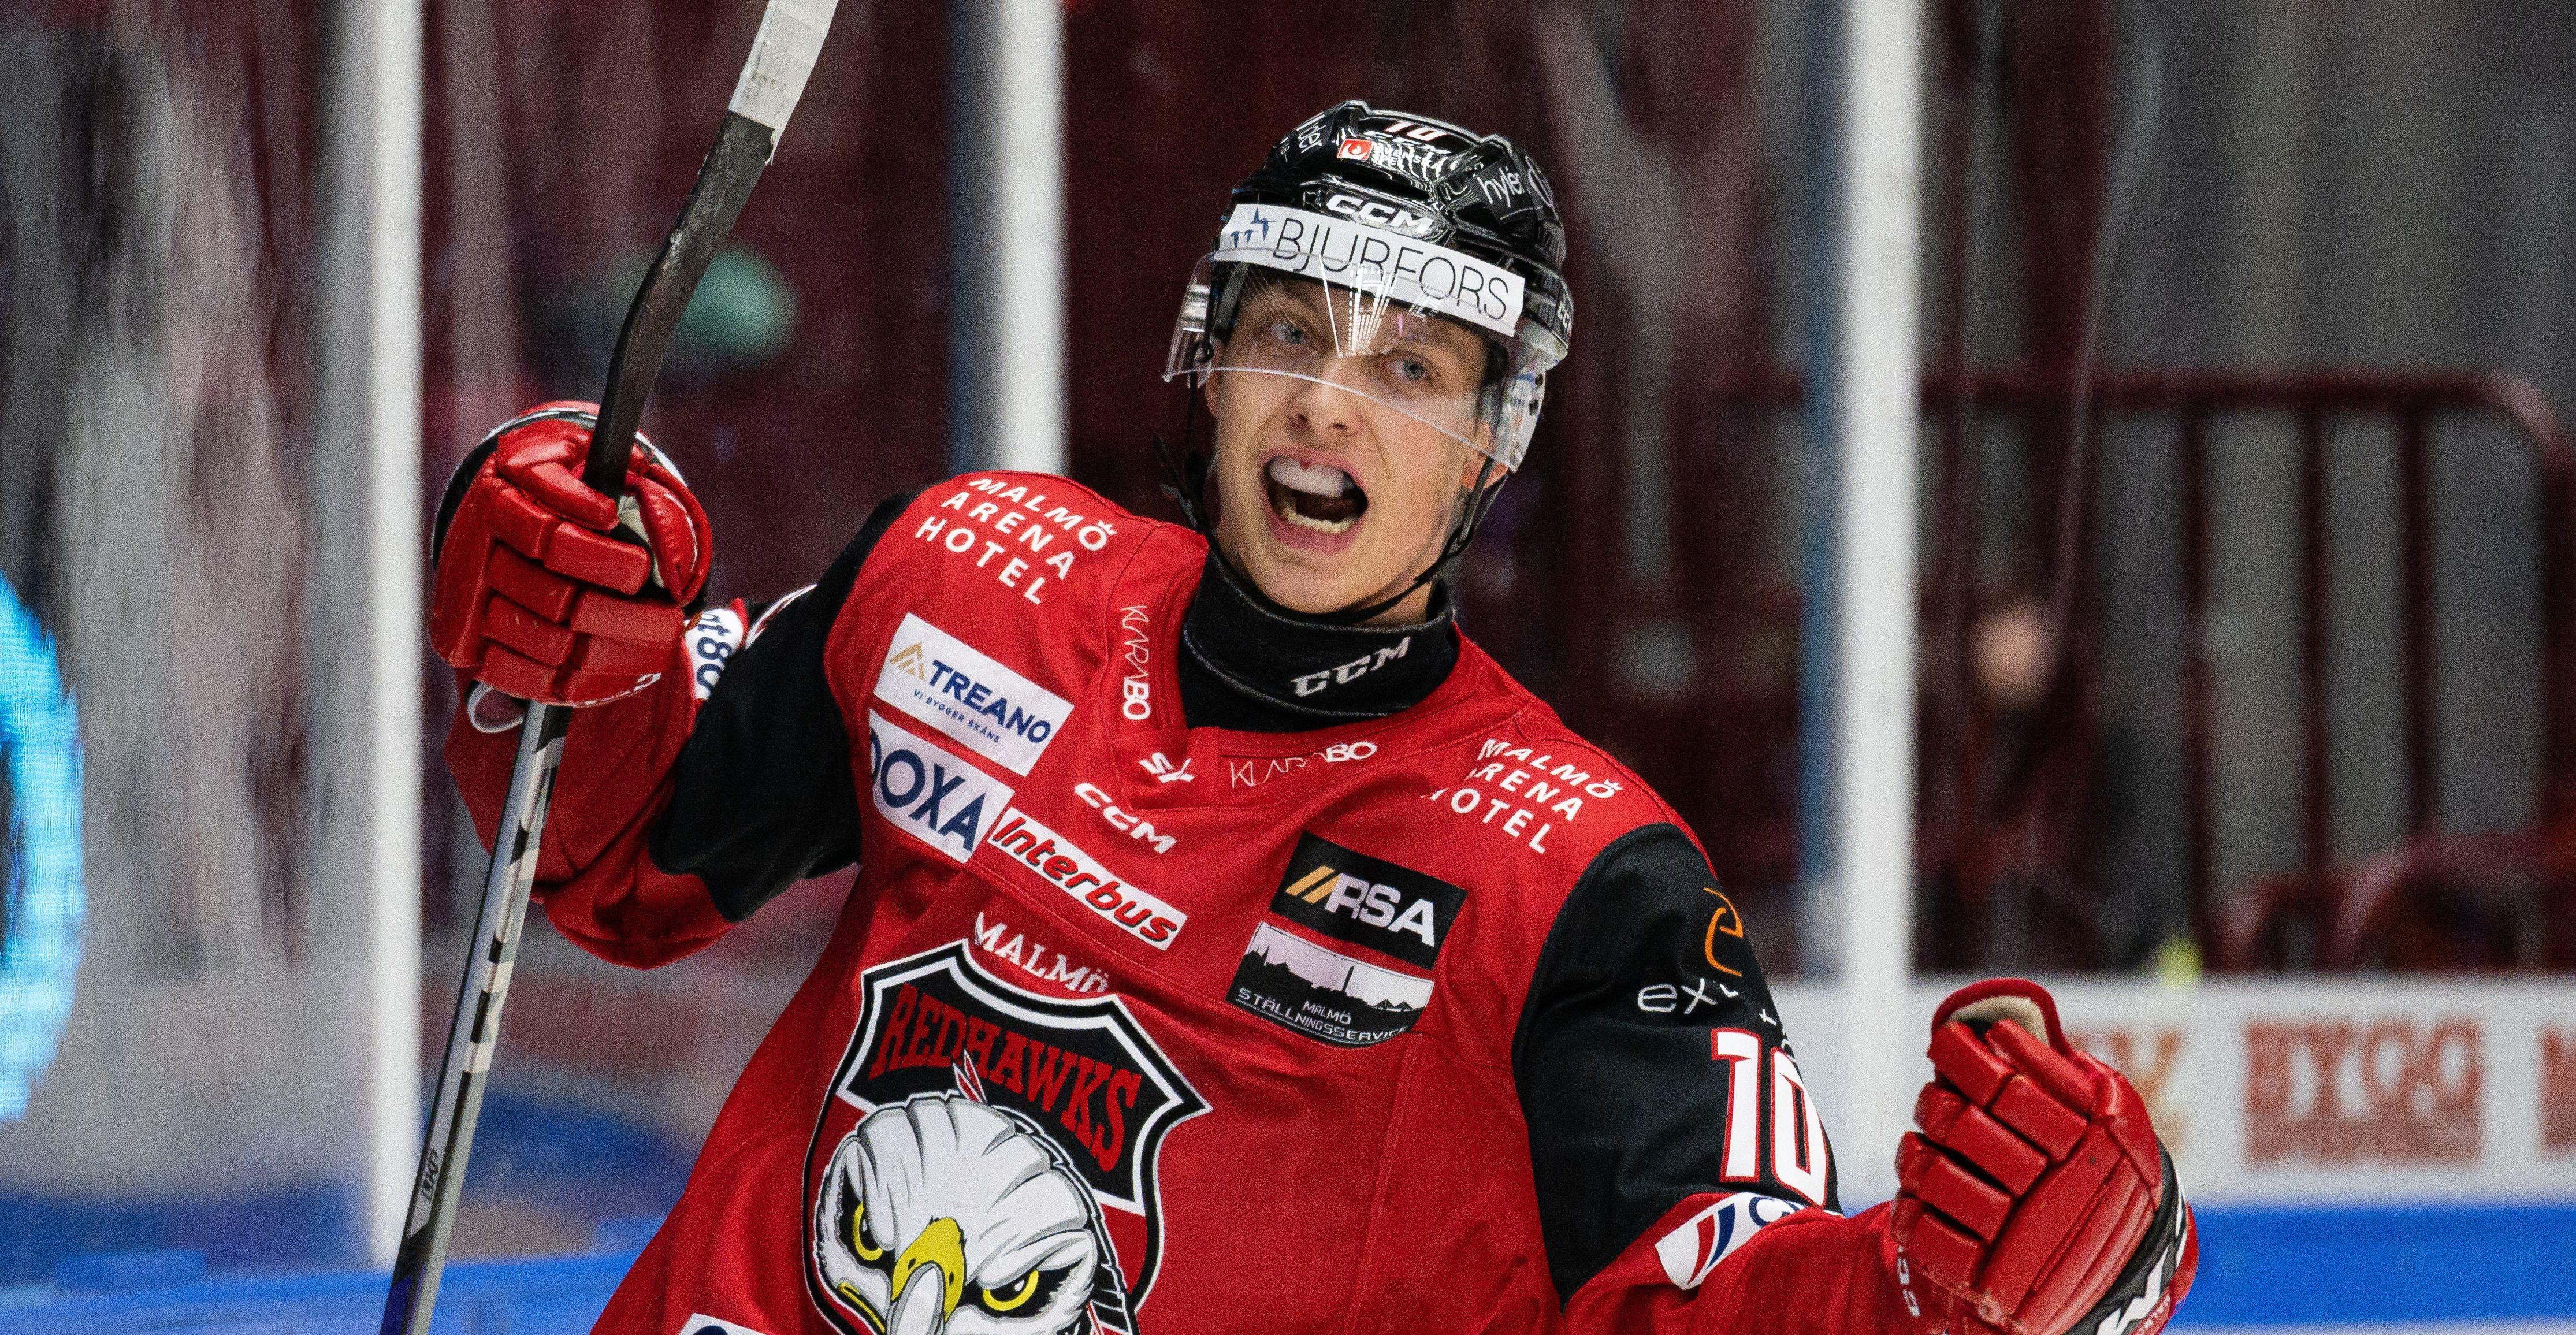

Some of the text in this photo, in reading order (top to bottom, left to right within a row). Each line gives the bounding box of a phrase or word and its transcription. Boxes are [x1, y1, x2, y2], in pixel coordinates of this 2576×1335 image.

[1326, 195, 1435, 233] CCM
[1273, 218, 1509, 320] BJURFORS
[941, 490, 1075, 581] ARENA
[968, 477, 1117, 551] MALMÖ
[915, 516, 1045, 605] HOTEL
[913, 689, 923, 700] VI
[925, 696, 965, 723] BYGGER
[928, 660, 1051, 743] TREANO
[1292, 637, 1411, 697] CCM
[870, 727, 987, 853] OXA
[1477, 738, 1623, 798] MALMÖ
[1075, 783, 1178, 854] CCM
[991, 816, 1179, 944] Interbus
[975, 912, 1109, 993] MALMÖ
[1302, 1000, 1351, 1025] MALMÖ
[868, 983, 1143, 1172] REDHAWKS
[1711, 1028, 1828, 1207] 10
